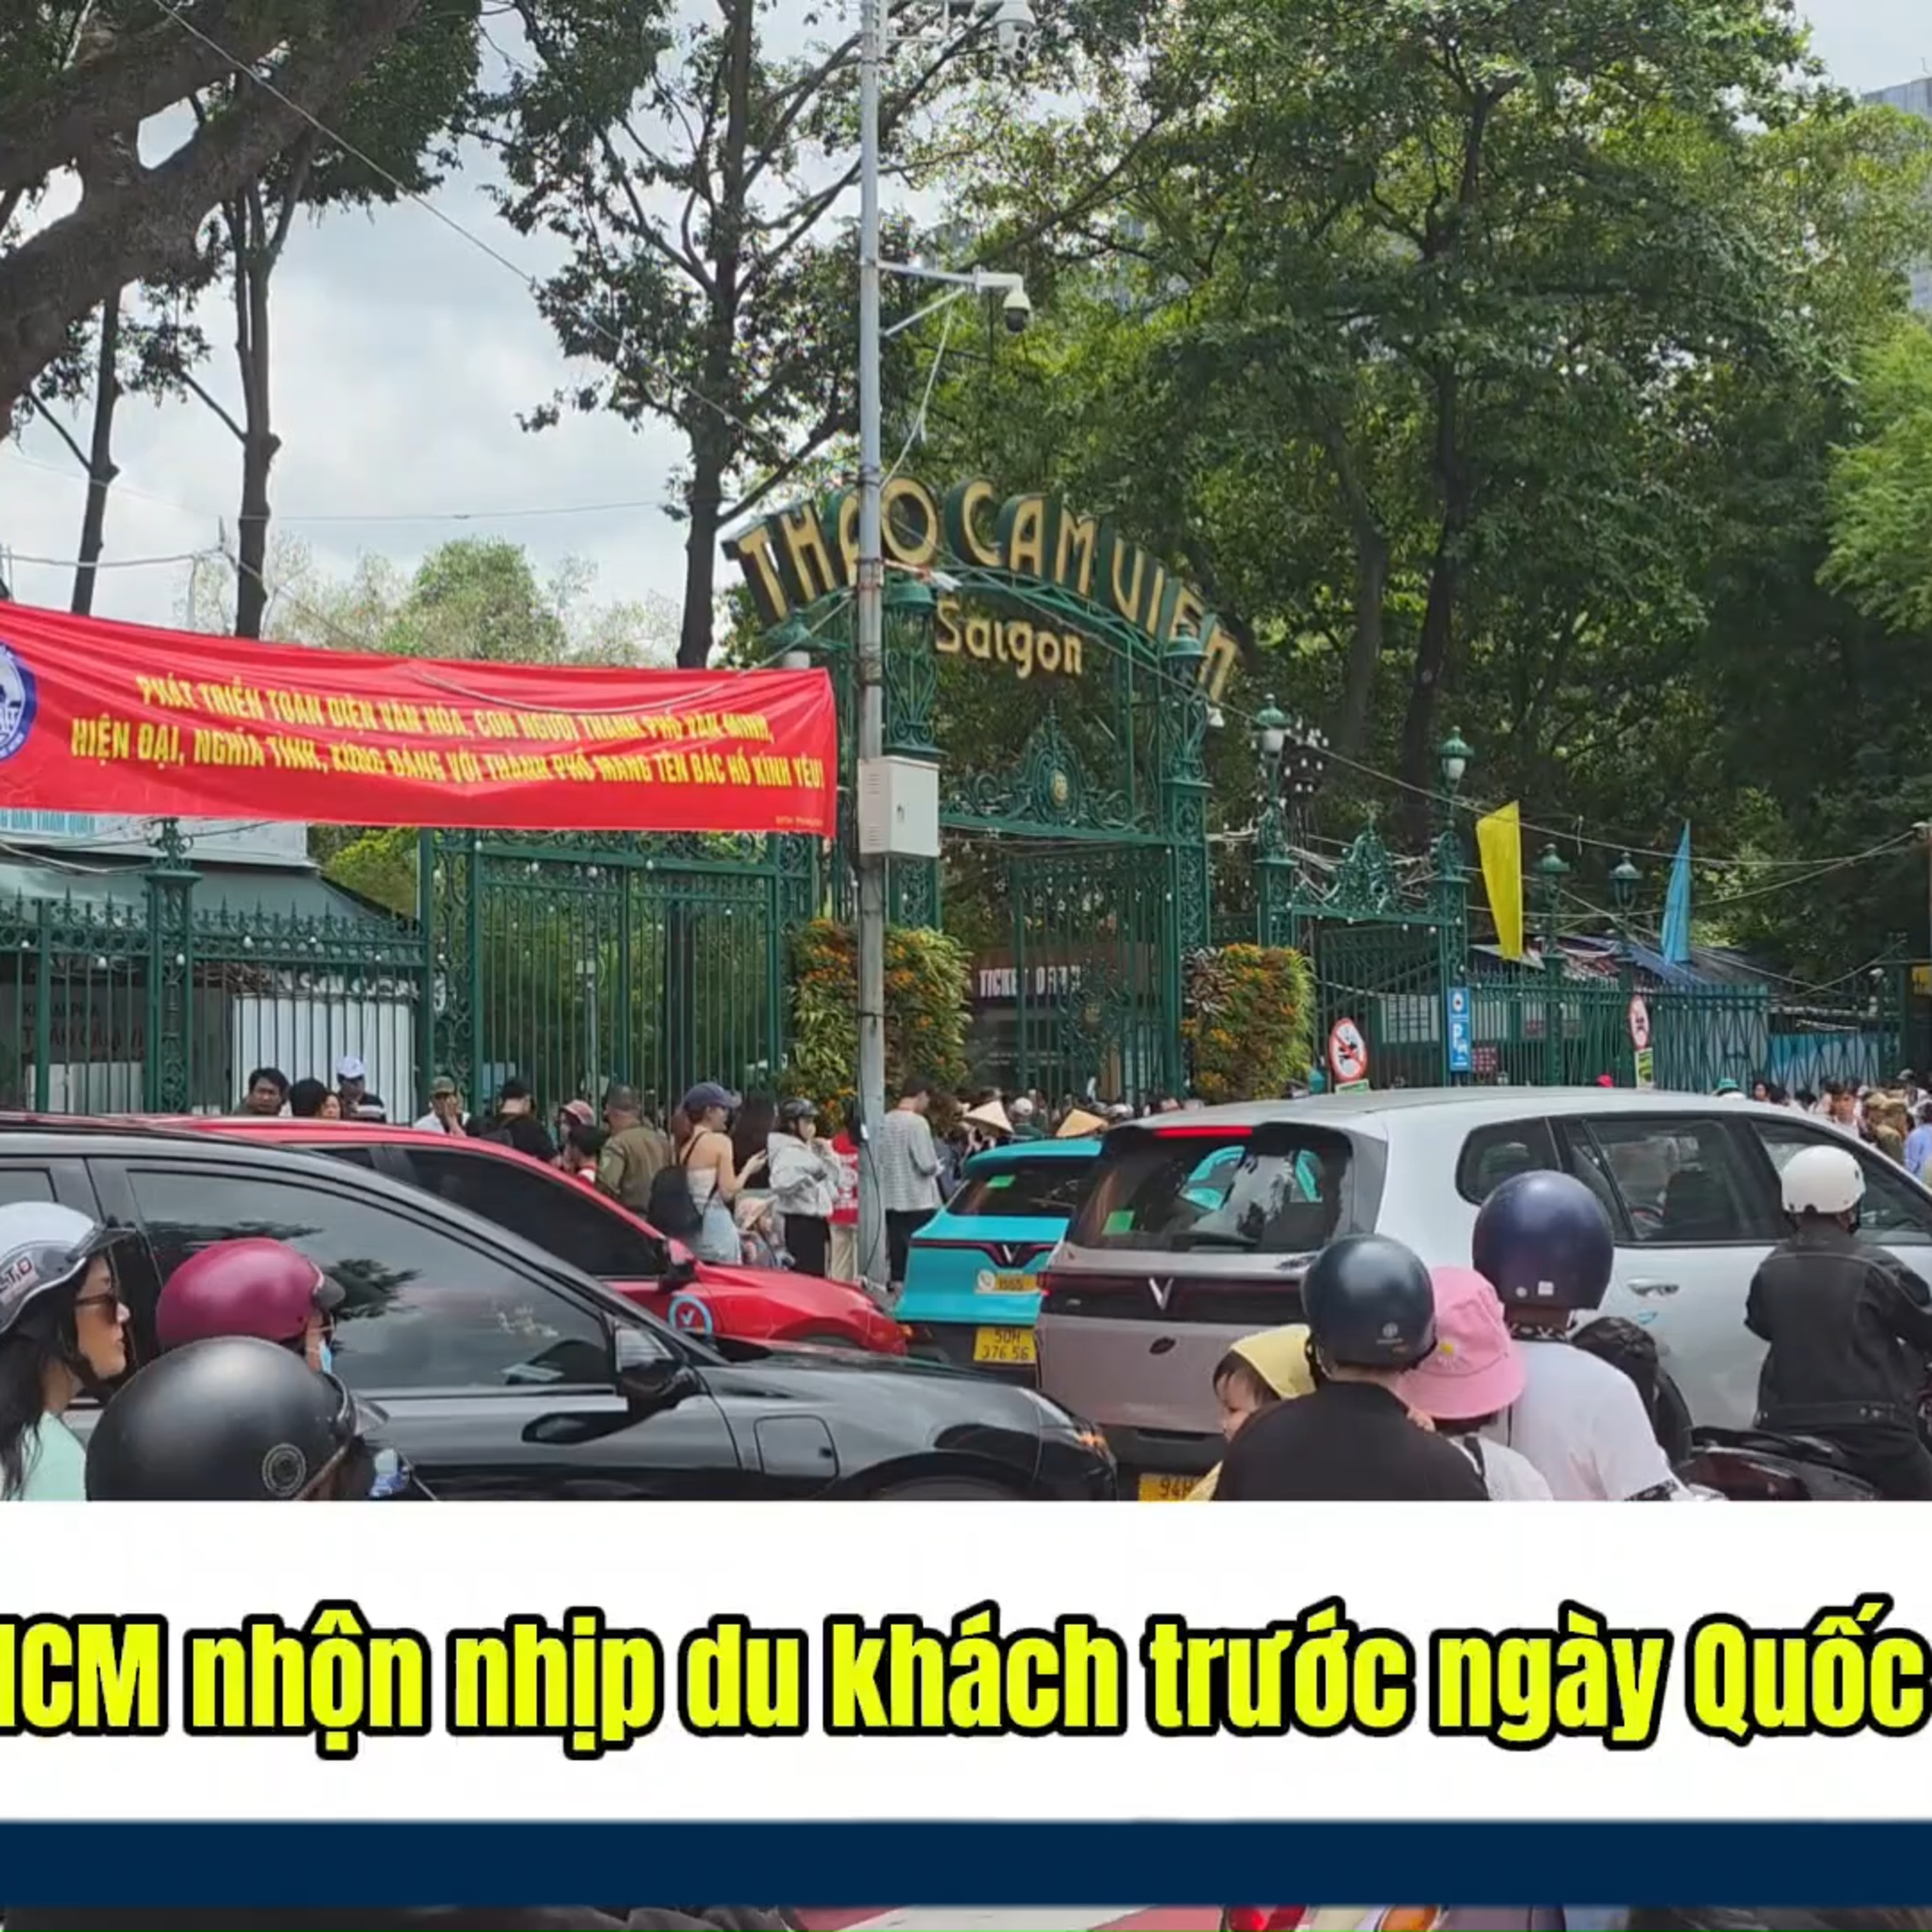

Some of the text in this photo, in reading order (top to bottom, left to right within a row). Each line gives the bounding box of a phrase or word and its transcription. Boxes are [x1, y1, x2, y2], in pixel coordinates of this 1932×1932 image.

[936, 600, 1083, 679] Saigon
[71, 712, 131, 766] HIỆN
[137, 722, 185, 770] ĐẠI,
[689, 747, 727, 784] BÁC
[979, 967, 1030, 998] TICKE
